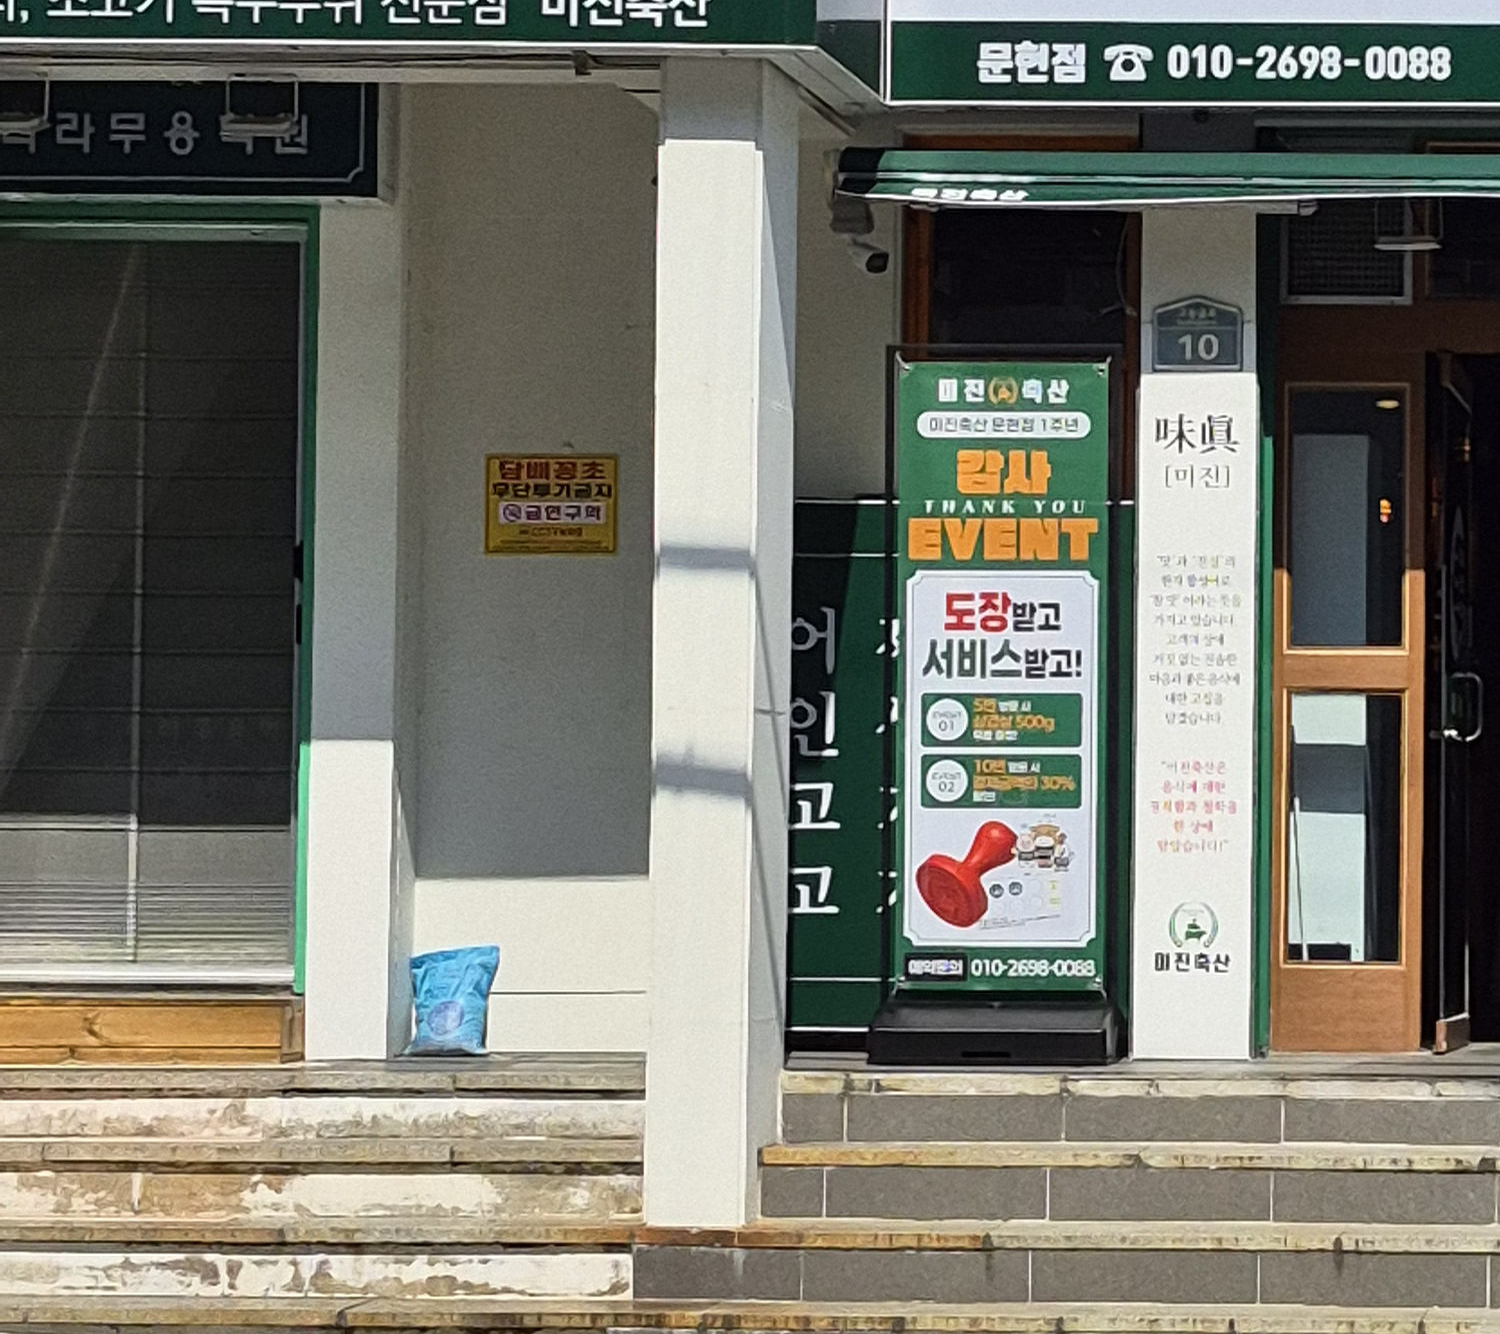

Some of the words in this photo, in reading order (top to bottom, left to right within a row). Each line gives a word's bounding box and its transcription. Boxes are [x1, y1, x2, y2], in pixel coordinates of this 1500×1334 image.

[976, 40, 1087, 85] 문현점
[1166, 44, 1452, 82] 010-2698-0088
[1178, 333, 1219, 361] 10
[938, 378, 985, 403] 미진
[1021, 378, 1070, 404] 축산
[929, 417, 988, 433] 미진축산
[1041, 417, 1079, 433] 1주년
[1154, 413, 1240, 454] 味眞
[499, 459, 607, 481] 담배꽁초
[956, 449, 1052, 495] 감사
[1165, 464, 1230, 489] [미진]
[491, 482, 613, 499] 무단투기금지
[524, 504, 602, 521] 금연구역
[924, 499, 1016, 515] THANK
[1033, 499, 1086, 515] YOU
[907, 517, 1099, 562] EVENT
[944, 591, 1062, 633] 도장받고
[922, 638, 1083, 679] 서비스받고!
[938, 720, 955, 731] 01
[938, 780, 955, 792] 02
[1153, 952, 1231, 973] 미진축산
